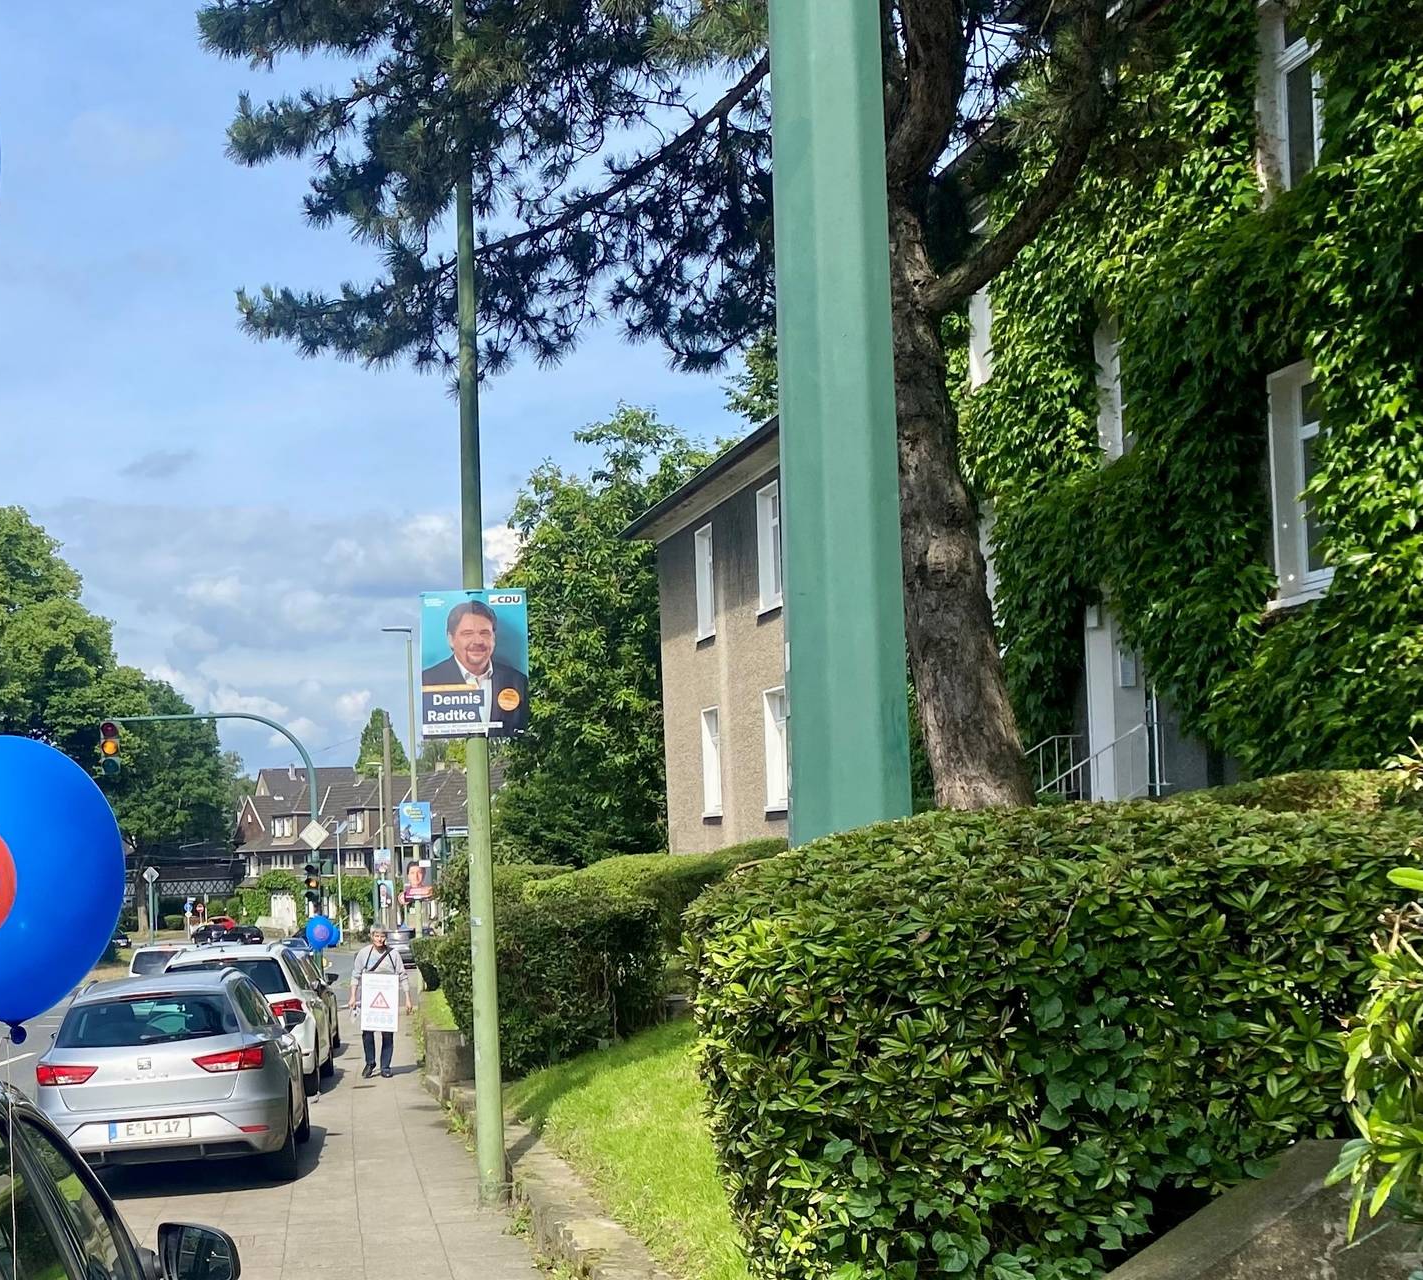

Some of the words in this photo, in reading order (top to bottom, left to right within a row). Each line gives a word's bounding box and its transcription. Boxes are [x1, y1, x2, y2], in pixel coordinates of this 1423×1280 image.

[497, 595, 521, 604] CDU
[432, 692, 482, 706] Dennis
[427, 709, 476, 722] Radtke
[164, 1120, 181, 1133] 17
